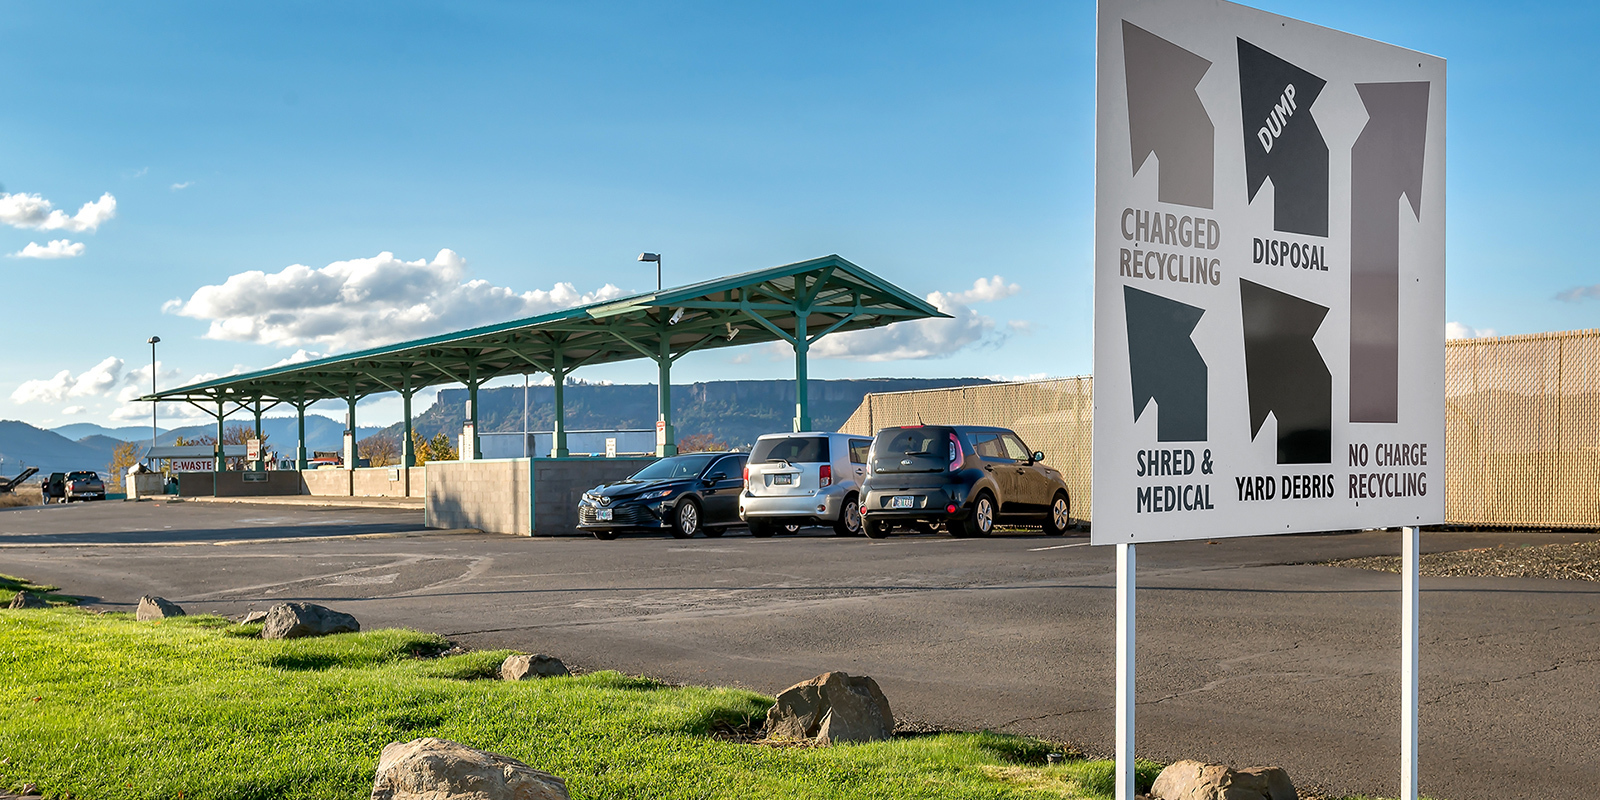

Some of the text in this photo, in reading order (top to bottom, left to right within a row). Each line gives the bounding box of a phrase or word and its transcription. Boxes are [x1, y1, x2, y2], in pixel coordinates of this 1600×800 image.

[1257, 84, 1297, 153] DUMP
[1120, 207, 1220, 249] CHARGED
[1119, 248, 1221, 286] RECYCLING
[1253, 237, 1329, 271] DISPOSAL
[173, 461, 212, 470] E-WASTE
[1136, 448, 1213, 477] SHRED &
[1348, 443, 1427, 467] NO CHARGE
[1136, 484, 1214, 513] MEDICAL
[1235, 474, 1335, 501] YARD DEBRIS
[1348, 472, 1427, 499] RECYCLING
